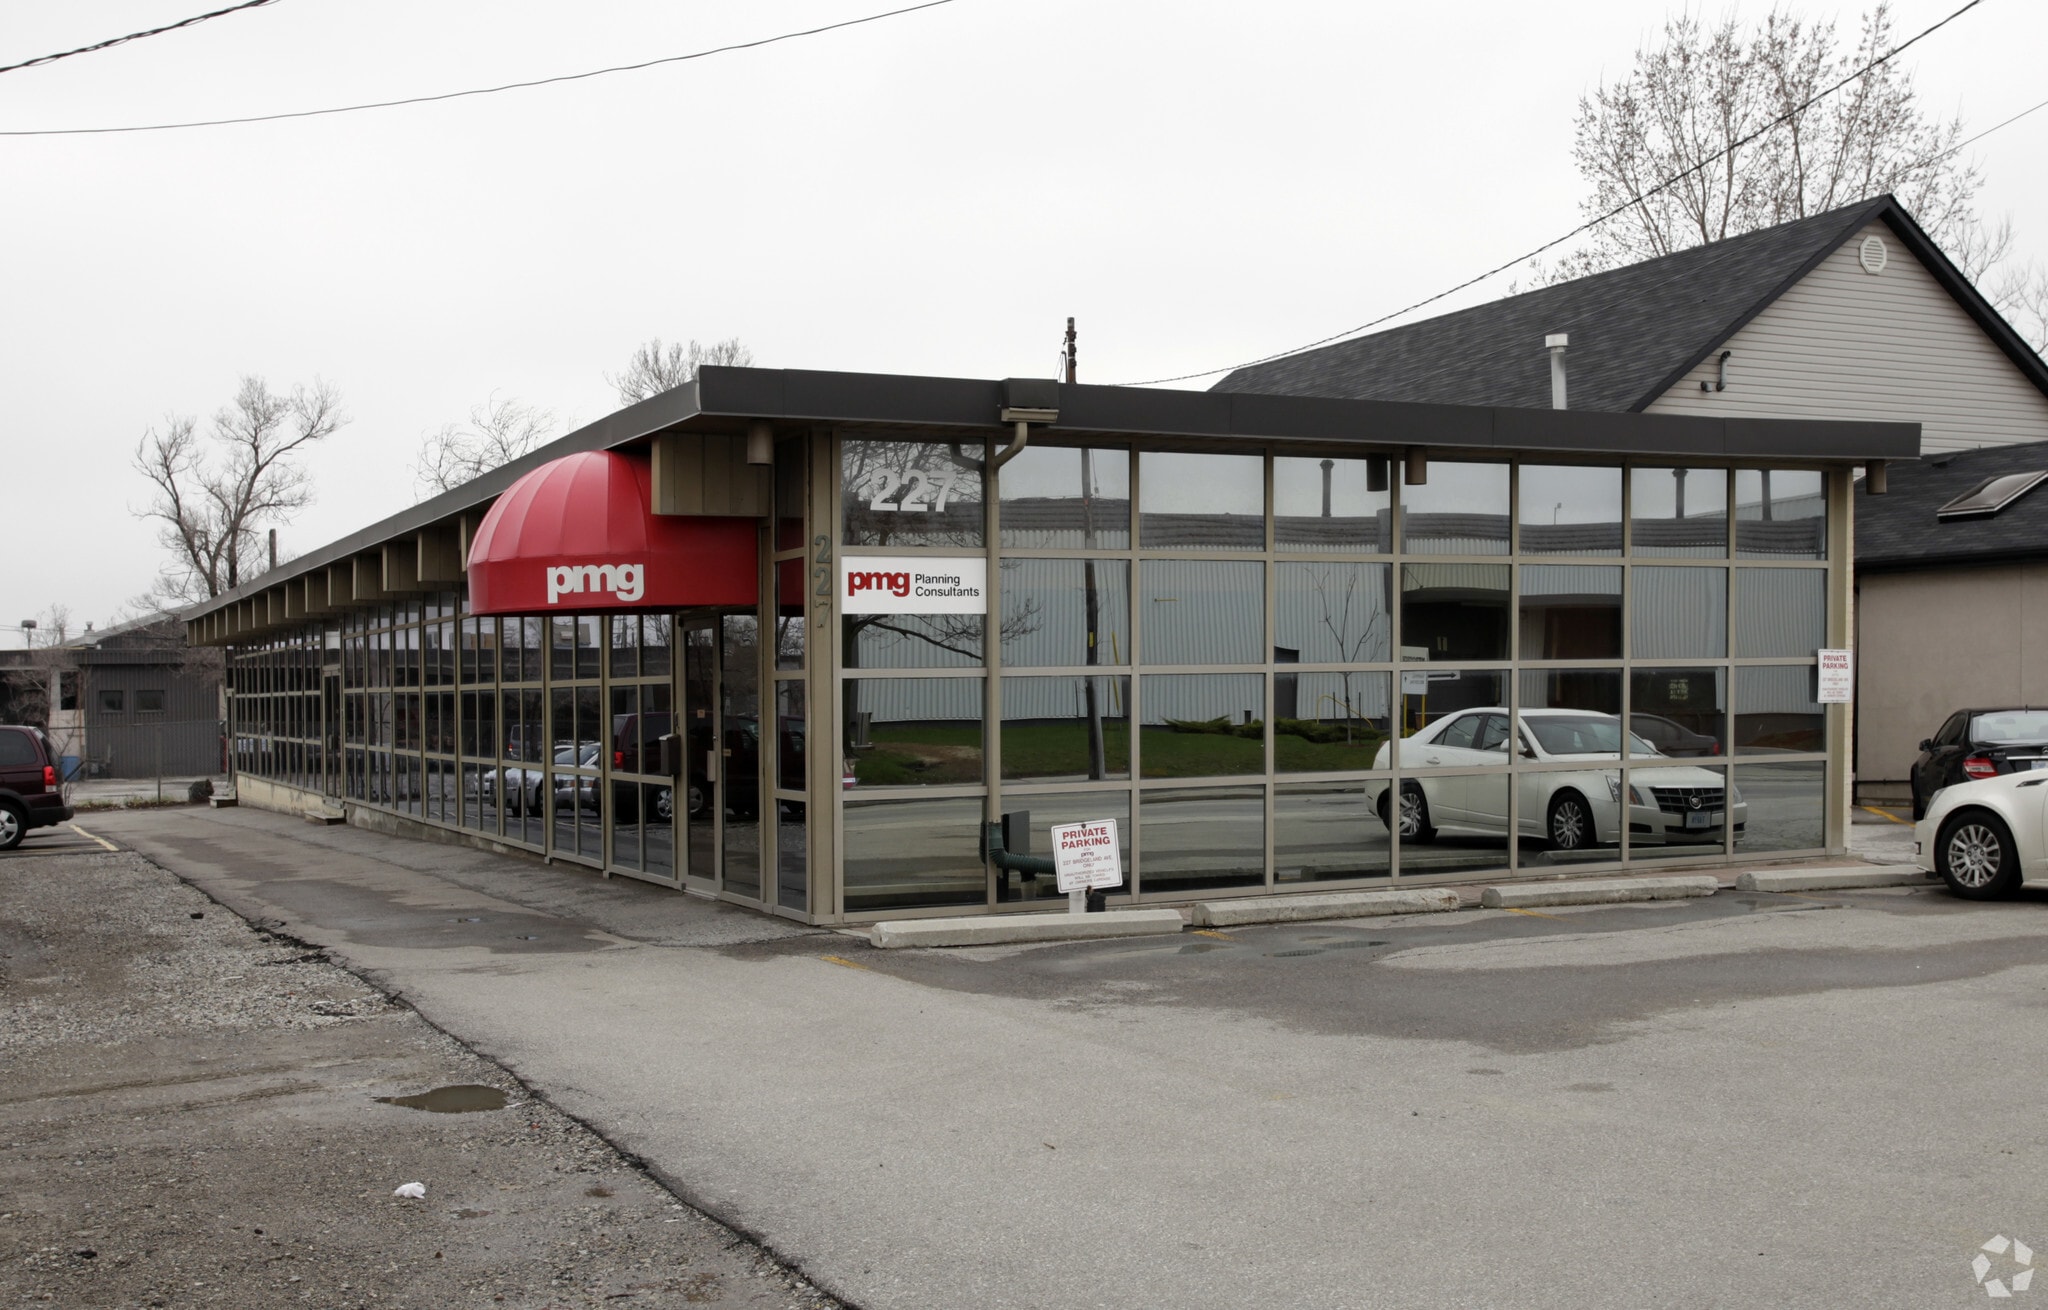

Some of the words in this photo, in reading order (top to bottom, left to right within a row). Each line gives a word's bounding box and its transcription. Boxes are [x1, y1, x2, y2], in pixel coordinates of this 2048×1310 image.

[870, 468, 957, 513] 227
[547, 563, 645, 604] pmg
[848, 571, 910, 598] pmg
[915, 573, 960, 585] Planning
[915, 586, 980, 597] Consultants
[1062, 827, 1107, 840] PRIVATE
[1061, 836, 1111, 850] PARKING
